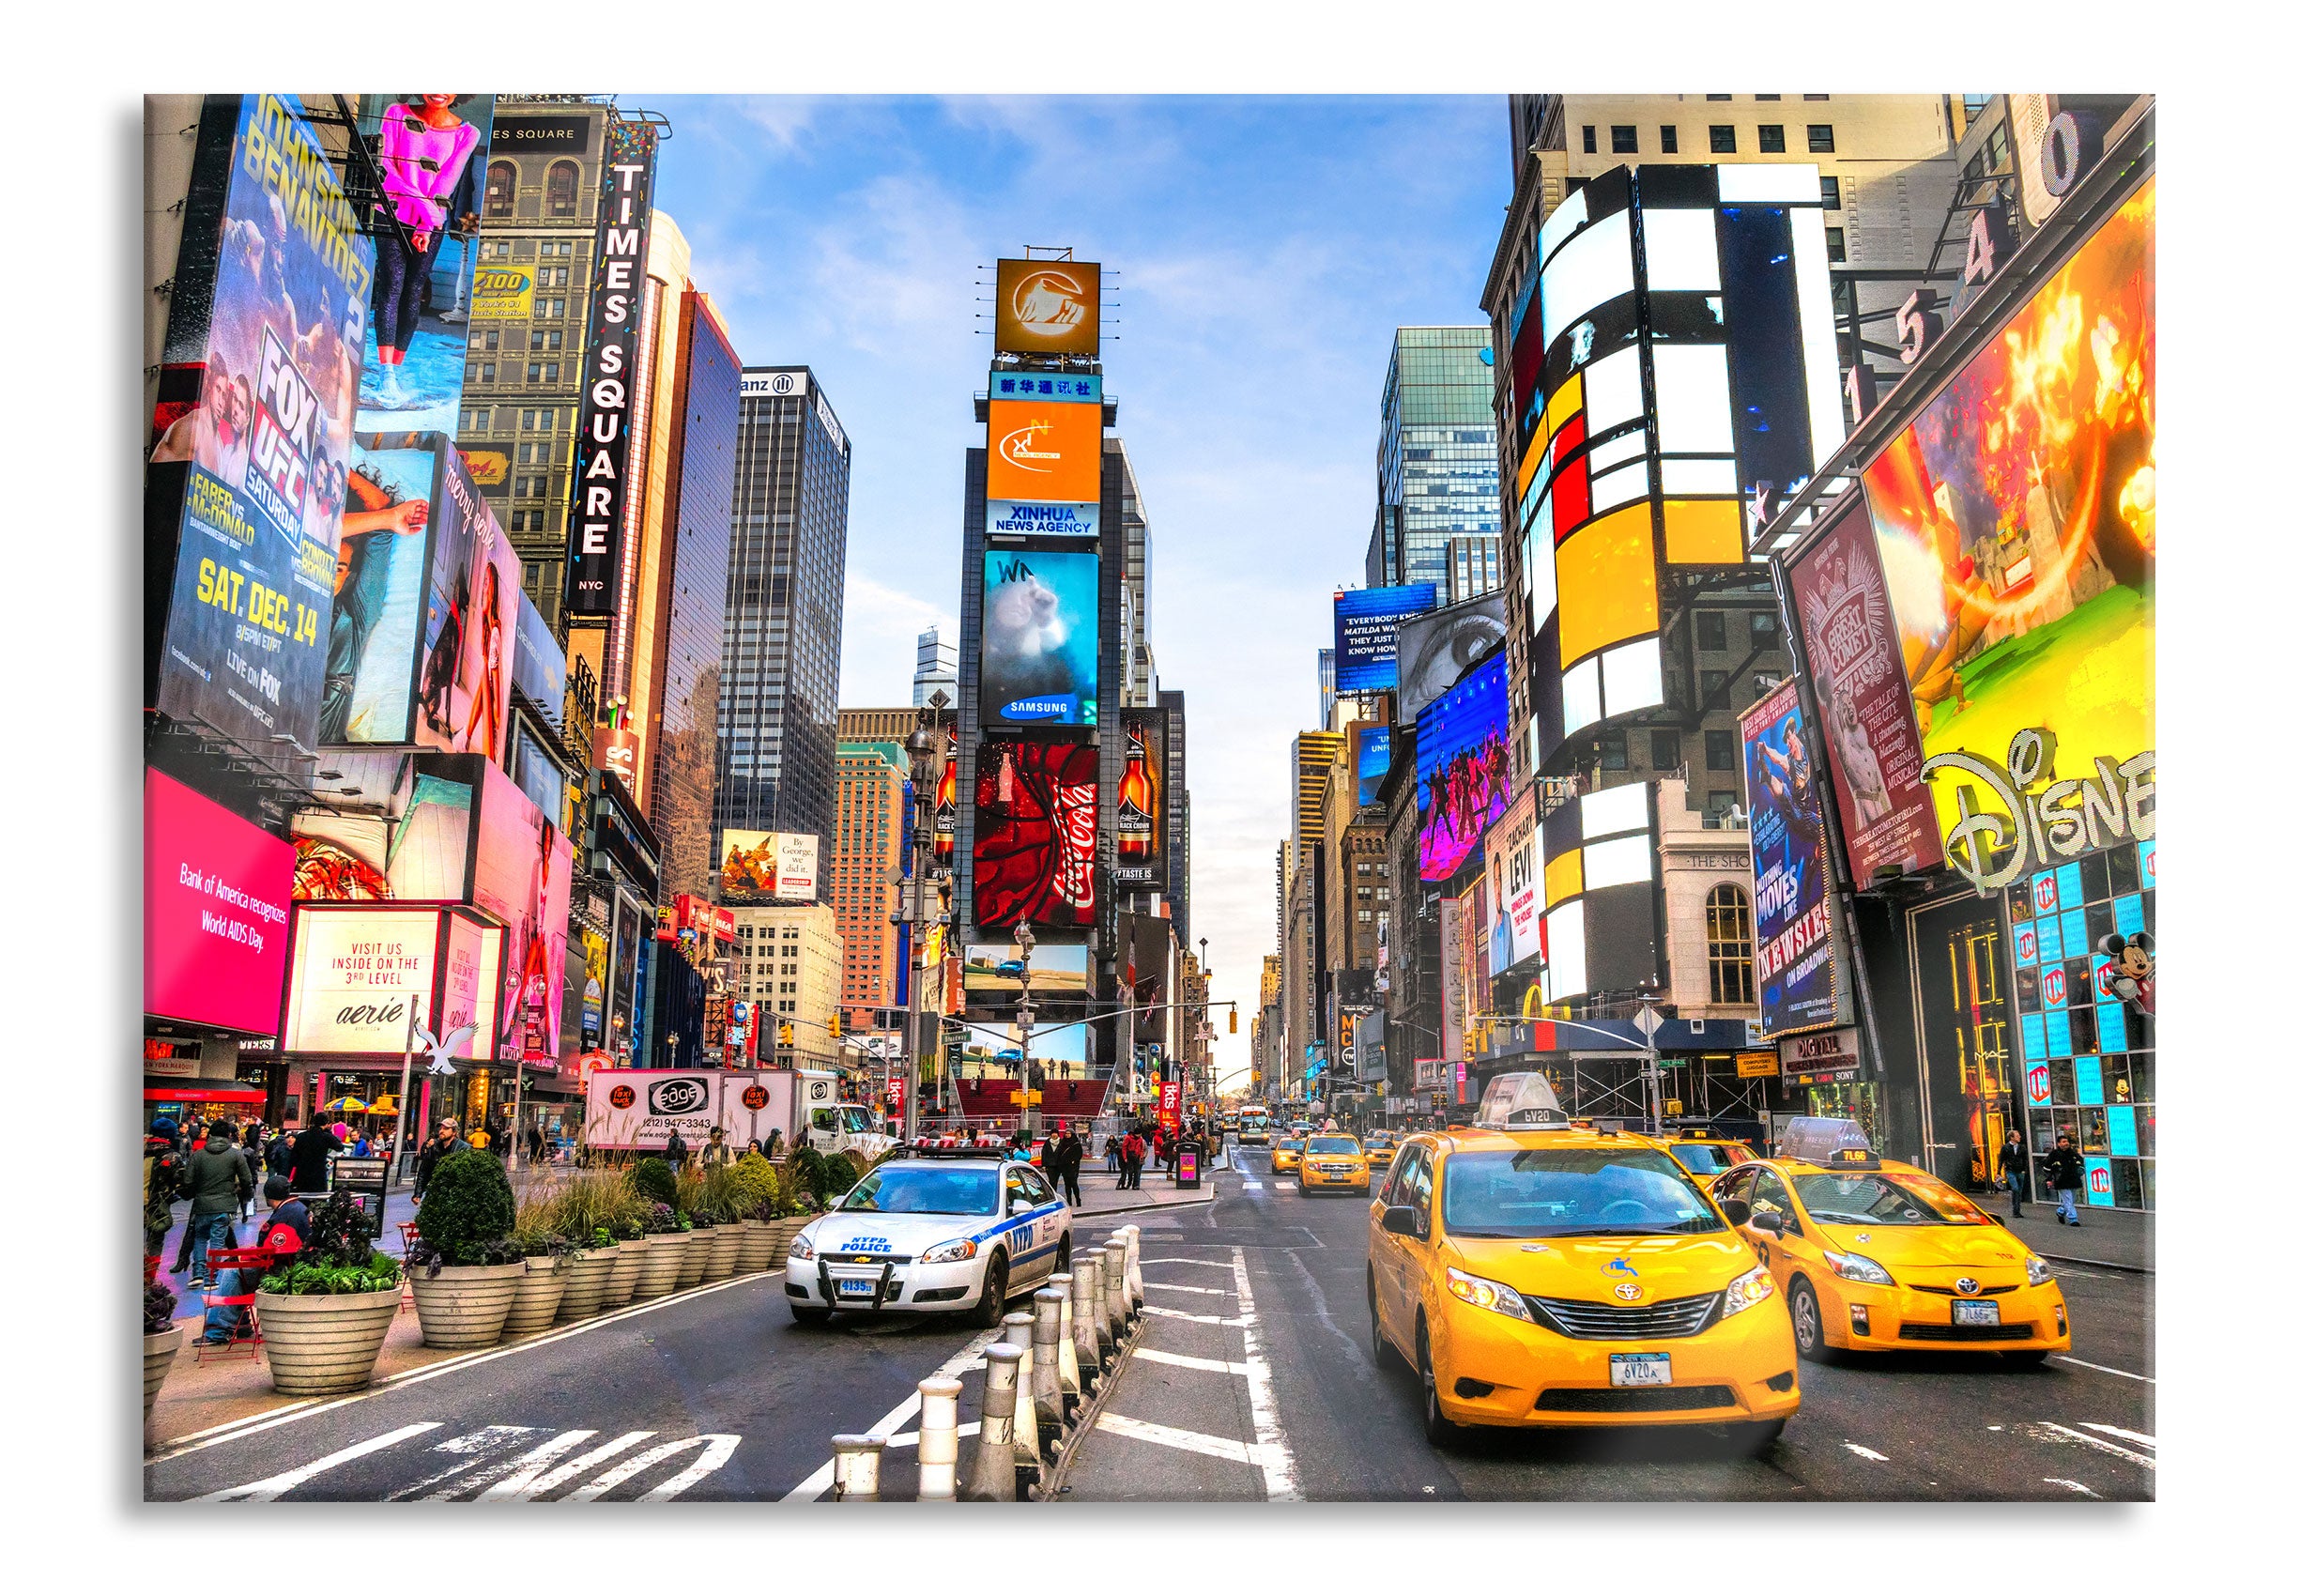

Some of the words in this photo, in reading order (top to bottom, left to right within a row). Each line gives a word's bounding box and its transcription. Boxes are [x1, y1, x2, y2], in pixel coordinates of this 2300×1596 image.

[516, 129, 575, 140] SQUARE
[604, 164, 644, 323] TIMES
[495, 309, 527, 317] Station
[258, 342, 317, 451] FOX
[1001, 377, 1092, 397] 新华通讯社
[581, 345, 626, 554] SQUARE
[253, 415, 305, 507] UFC
[195, 473, 233, 513] FABER
[232, 500, 245, 523] VS
[247, 466, 301, 546] SATURDAY
[445, 464, 475, 535] merry
[192, 493, 255, 547] McDONALD
[1010, 505, 1078, 523] XINHUA
[996, 520, 1035, 532] NEWS
[1035, 521, 1092, 534] AGENCY
[578, 580, 604, 591] NYC
[197, 558, 246, 618] SAT.
[248, 580, 291, 637] DEC.
[294, 603, 317, 648] 14
[236, 624, 262, 647] 8/5PM
[1344, 625, 1380, 636] MATILDA
[1828, 604, 1862, 650] GREAT
[1348, 647, 1375, 655] KNOW
[1377, 645, 1396, 653] HOW
[1349, 637, 1371, 646] THEY
[1372, 636, 1392, 644] JUST
[1831, 623, 1869, 673] COMET
[226, 648, 247, 679] LIVE
[247, 666, 260, 689] ON
[259, 667, 282, 706] FOX
[1010, 701, 1067, 714] SAMSUNG
[1876, 691, 1891, 712] TALK
[1891, 682, 1900, 700] OF
[1868, 711, 1883, 732] THE
[1886, 744, 1918, 775] ORIGINAL
[1894, 822, 1910, 836] STREET
[782, 846, 814, 858] George,
[793, 837, 804, 848] By
[786, 865, 799, 873] did
[800, 865, 808, 873] it.
[1144, 869, 1151, 879] IS
[1510, 842, 1531, 897] LEVI
[1756, 859, 1783, 896] NOTHING
[179, 862, 203, 891] Bank
[204, 874, 216, 895] of
[215, 878, 249, 909] America
[249, 897, 286, 925] recognizes
[1757, 865, 1798, 926] MOVES
[1784, 898, 1798, 923] LIKE
[202, 909, 227, 937] World
[227, 919, 248, 944] AIDS
[248, 927, 264, 954] Day.
[352, 943, 382, 956] VISIT
[387, 943, 403, 955] US
[332, 958, 372, 970] INSIDE
[376, 958, 393, 970] ON
[398, 958, 419, 970] THE
[345, 972, 364, 984] 3RD
[368, 972, 402, 985] LEVEL
[1786, 972, 1797, 989] ON
[336, 997, 405, 1025] aerie
[1835, 1070, 1855, 1081] SONY
[661, 1086, 697, 1106] edge
[746, 1090, 765, 1098] taxi
[890, 1082, 899, 1105] tkts
[1164, 1084, 1174, 1110] tkts
[665, 1118, 711, 1128] 947-3343
[1843, 1151, 1866, 1161] 7L66
[840, 1243, 892, 1253] POLICE
[1013, 1224, 1033, 1254] NYPD
